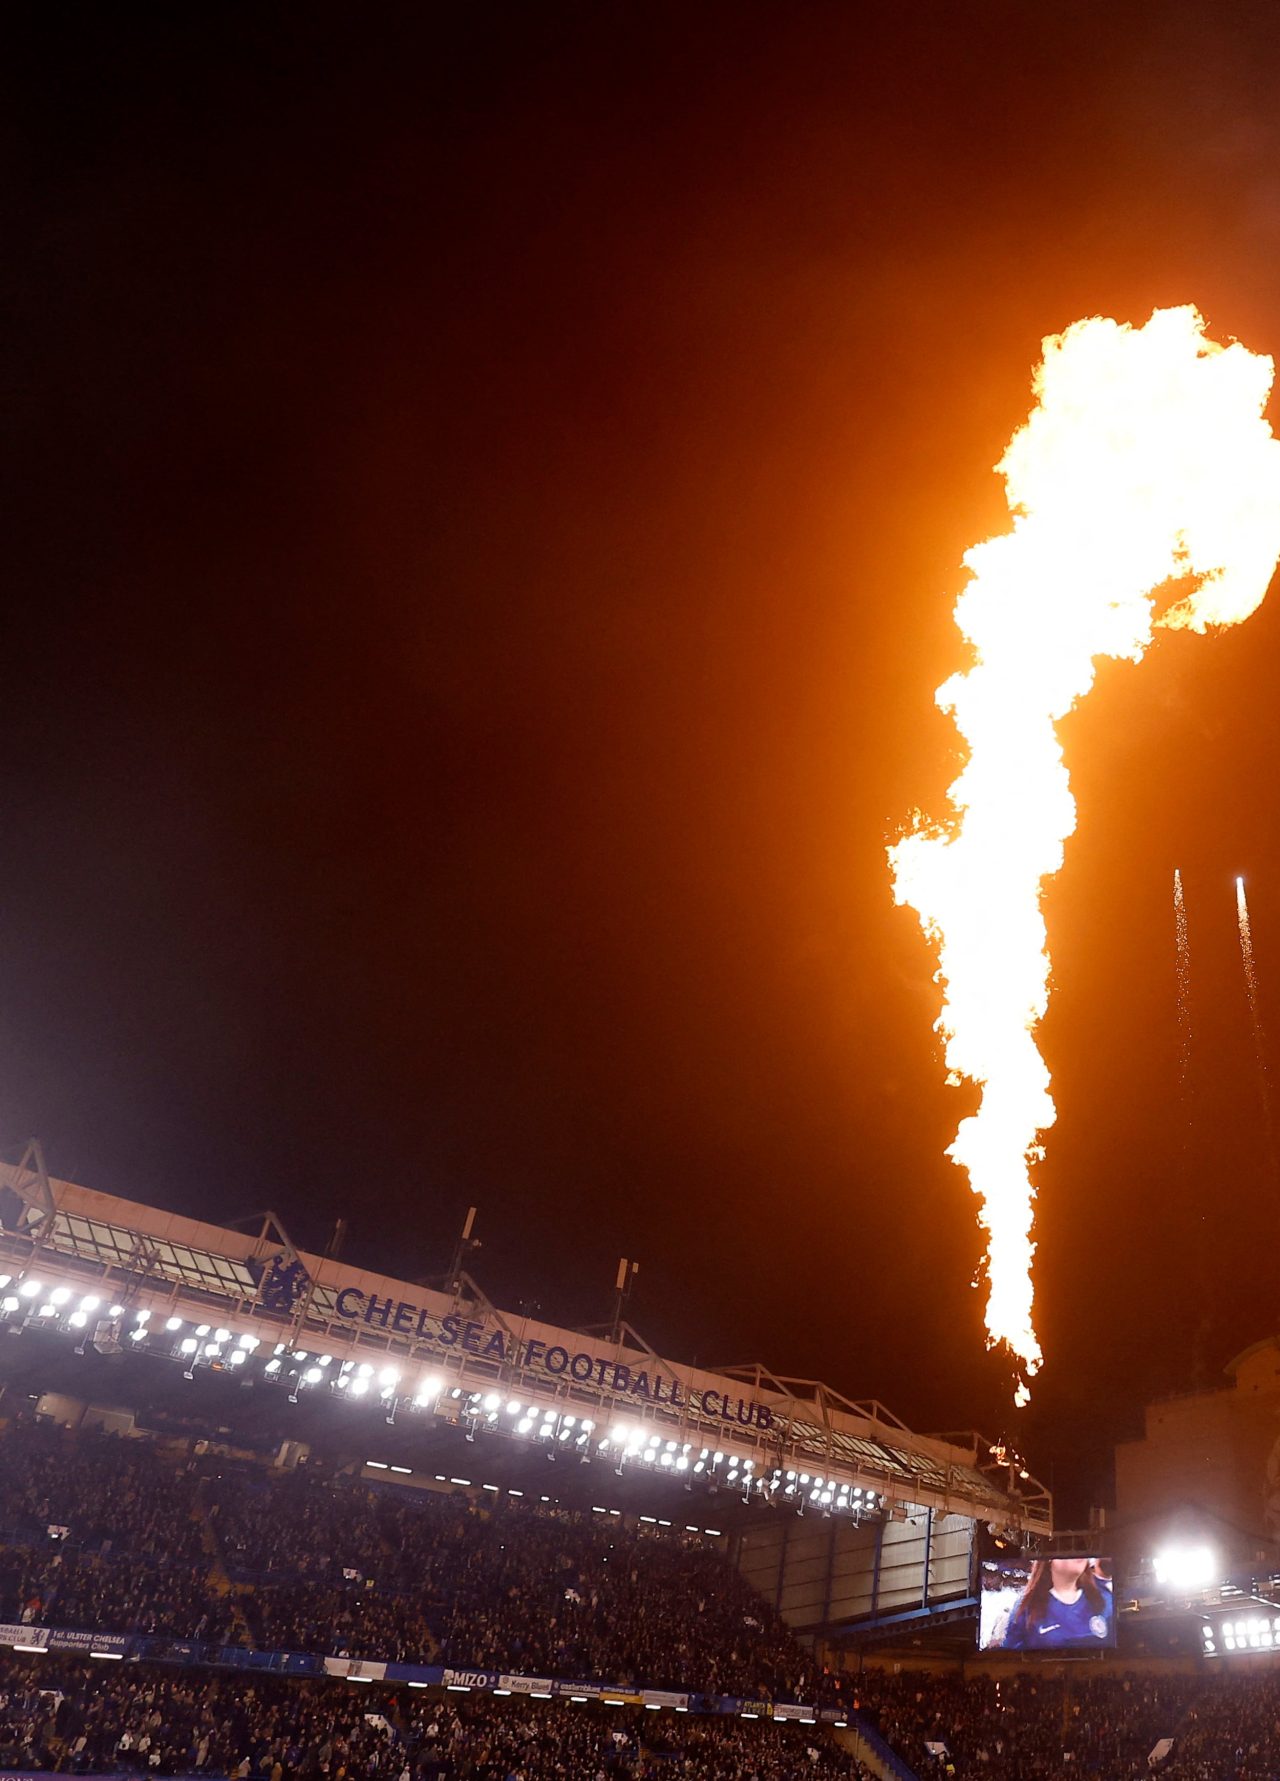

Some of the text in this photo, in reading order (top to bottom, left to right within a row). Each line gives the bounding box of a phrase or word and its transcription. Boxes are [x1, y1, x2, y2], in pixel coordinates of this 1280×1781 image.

[334, 1286, 772, 1430] CHELSEA FOOTBALL CLUB
[50, 1639, 110, 1651] Supporters Club
[67, 1632, 93, 1641] ULSTER
[93, 1635, 125, 1645] CHELSEA
[453, 1672, 487, 1688] MIZO
[511, 1680, 530, 1691] Kerry
